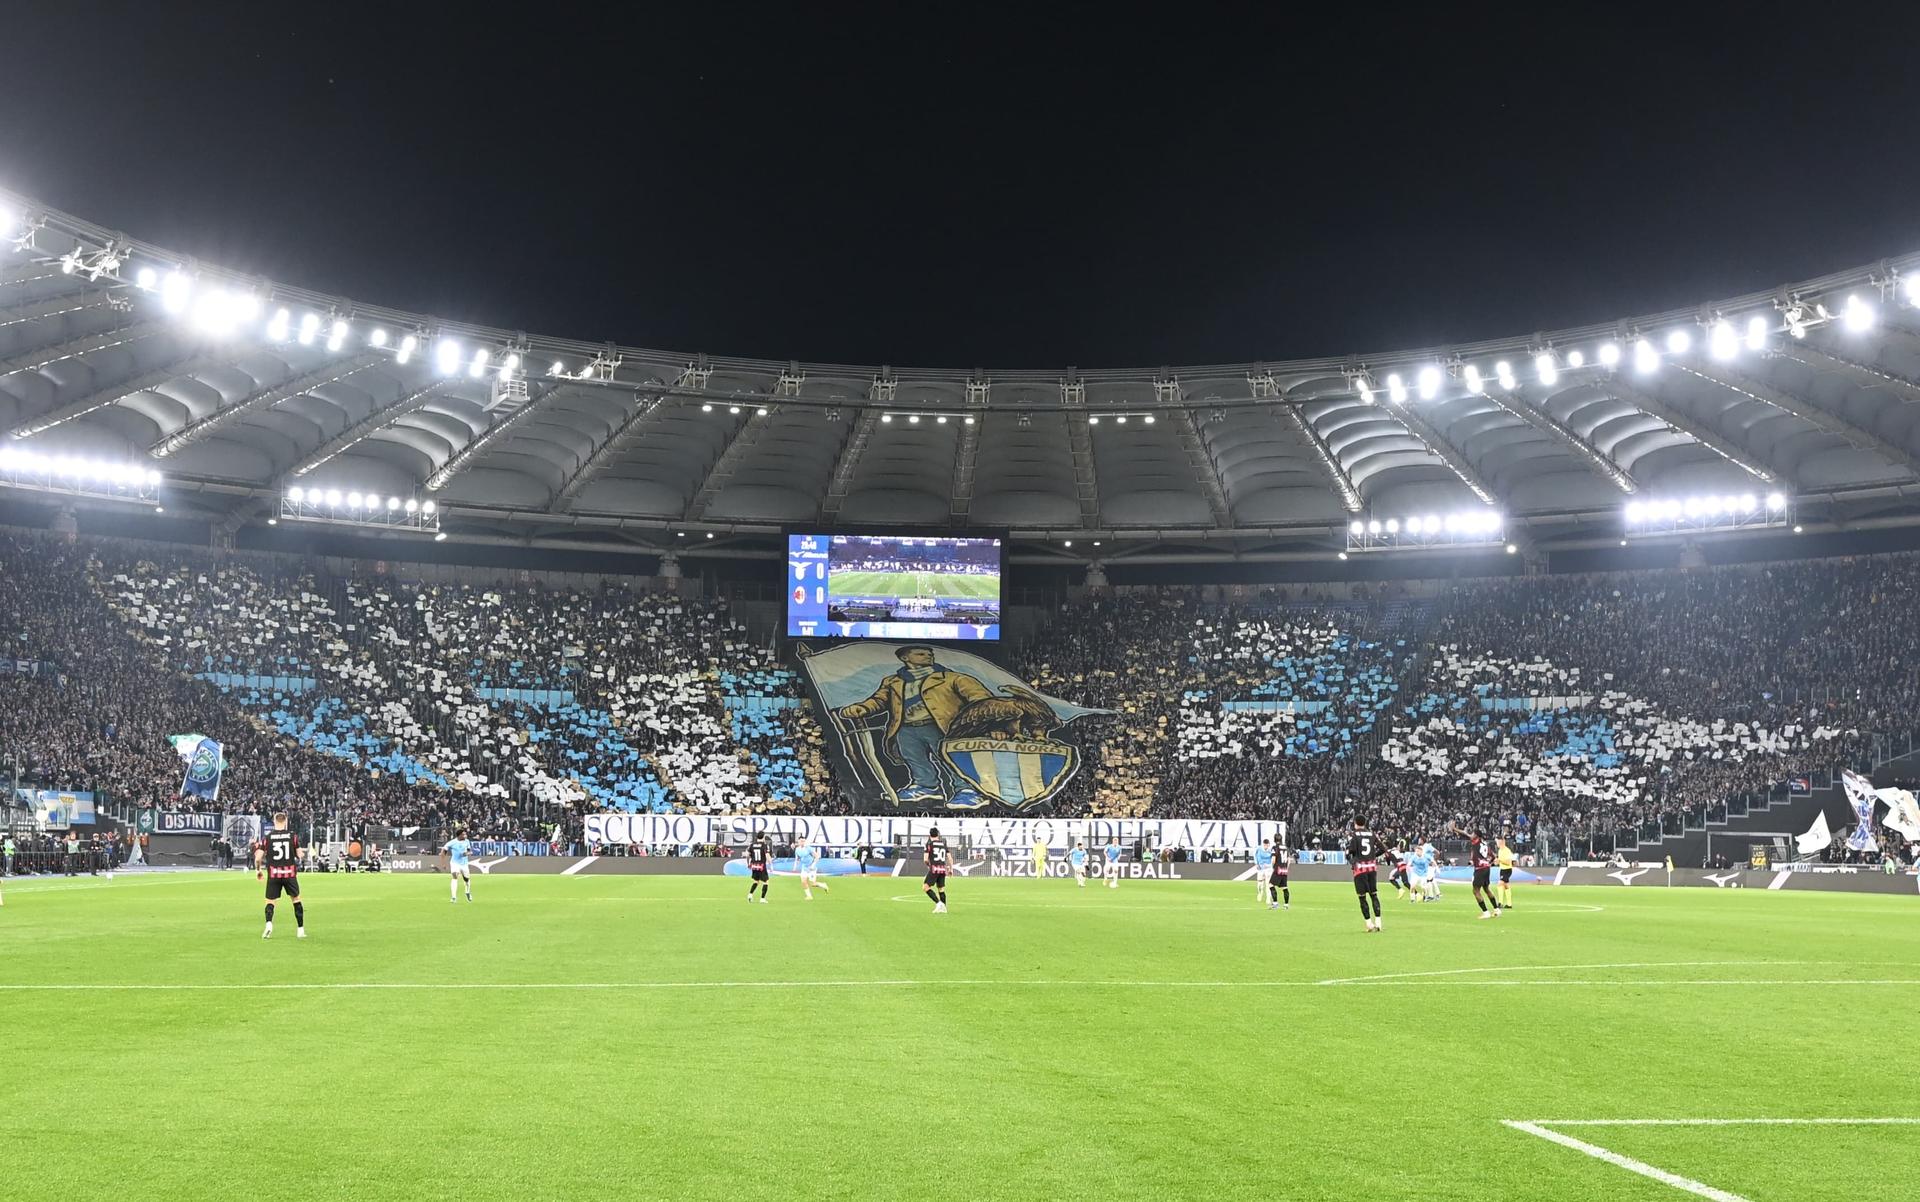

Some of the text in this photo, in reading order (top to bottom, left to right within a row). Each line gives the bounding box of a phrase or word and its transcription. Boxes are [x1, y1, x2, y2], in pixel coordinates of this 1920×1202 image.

[952, 741, 1009, 751] CURVA
[165, 813, 215, 830] DISTINTI
[587, 816, 695, 843] SCUDO
[731, 816, 833, 843] SPADA
[272, 841, 290, 860] 31
[753, 848, 762, 862] 11
[932, 847, 946, 862] 30
[1361, 838, 1371, 856] 5
[392, 860, 422, 869] 00:01
[990, 861, 1069, 877] MIZUNO
